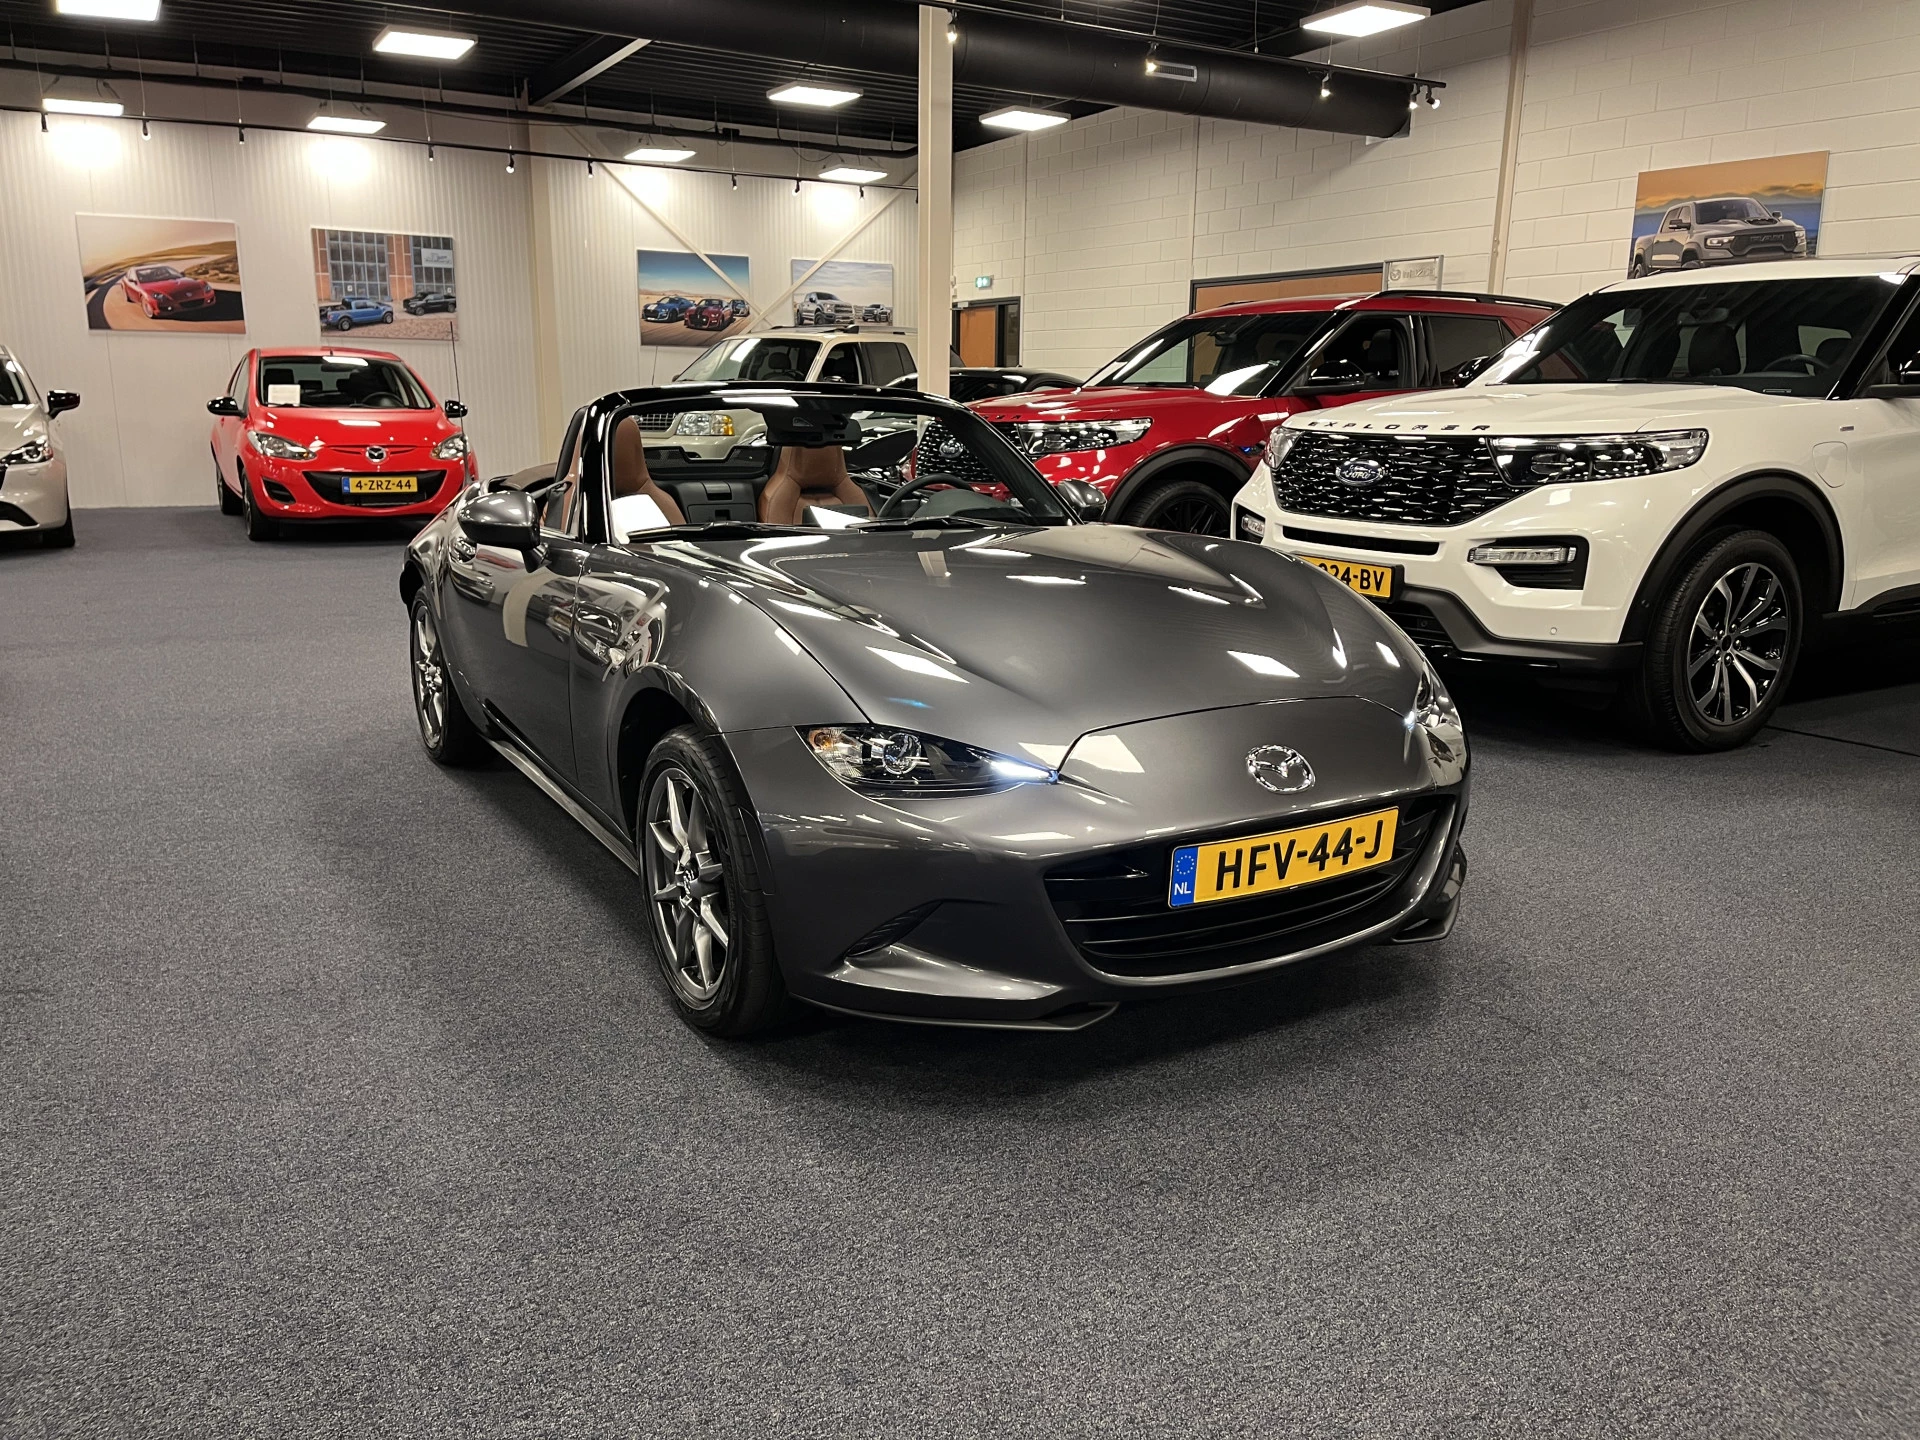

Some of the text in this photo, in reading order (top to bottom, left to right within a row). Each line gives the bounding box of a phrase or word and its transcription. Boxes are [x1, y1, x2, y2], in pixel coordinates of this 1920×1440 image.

[1308, 421, 1491, 431] EXPLORER
[355, 480, 412, 491] 4-ZRZ-44
[1174, 819, 1384, 895] NL HFV-44-J
